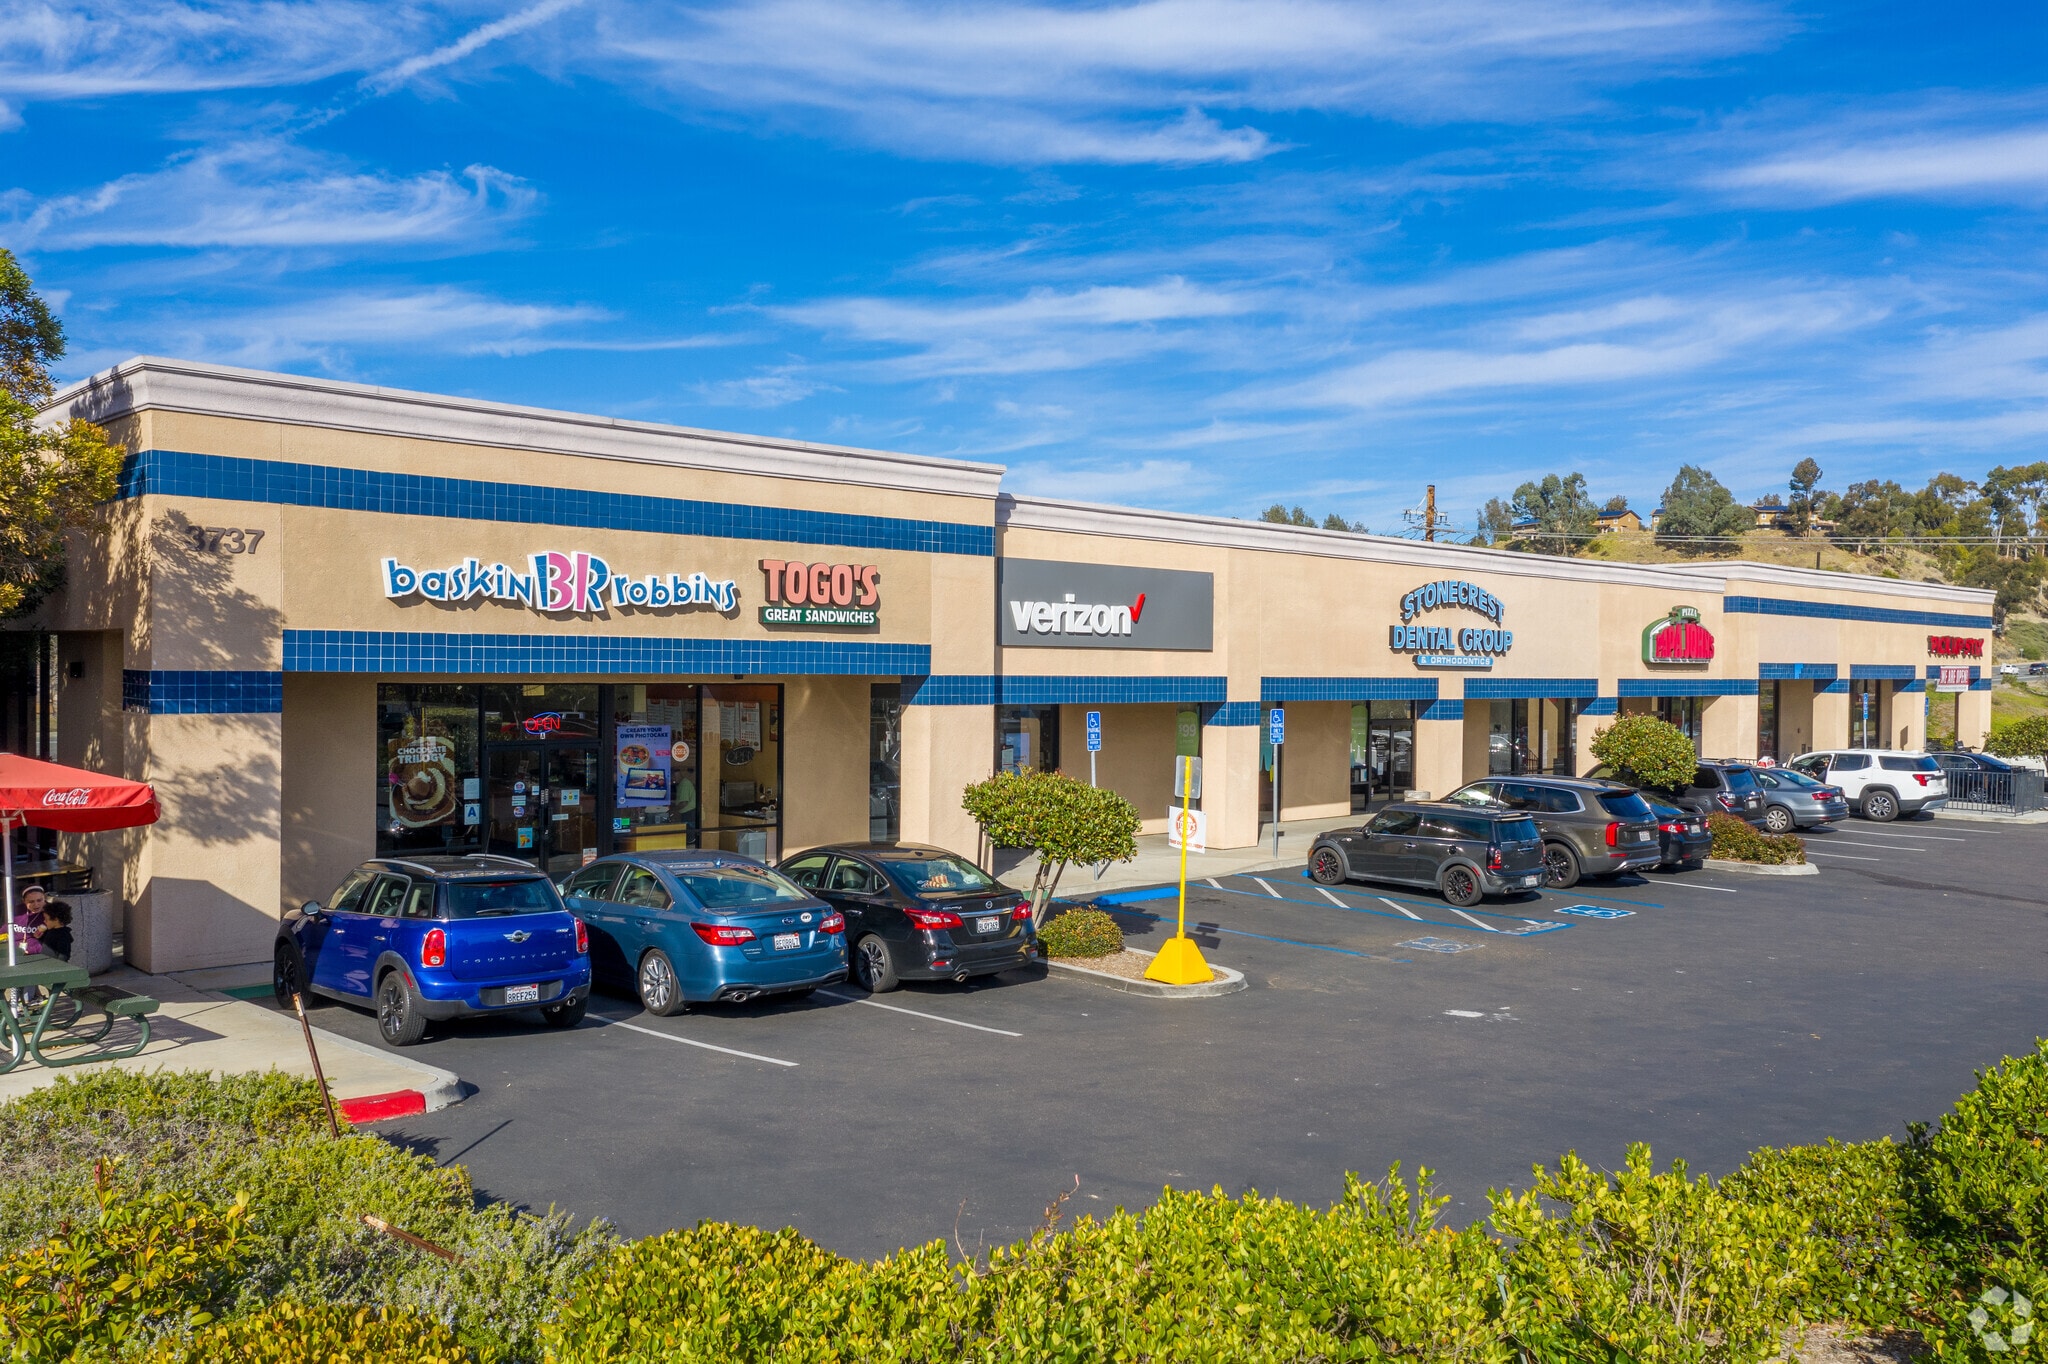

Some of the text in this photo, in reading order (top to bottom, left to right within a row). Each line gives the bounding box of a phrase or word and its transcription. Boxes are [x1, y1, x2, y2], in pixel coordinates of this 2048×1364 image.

[185, 526, 265, 554] 3737
[381, 557, 533, 607] baskin
[611, 571, 738, 612] robbins
[762, 559, 878, 606] TOGO'S
[1403, 579, 1506, 623] STONECREST
[765, 608, 875, 624] GREAT SANDWICHES
[1010, 593, 1132, 635] verizon
[1681, 608, 1698, 617] PIZZA
[1393, 625, 1514, 652] DENTAL GROUP
[1655, 623, 1682, 659] PAPA
[1421, 656, 1491, 665] & ORTHODONTICS
[525, 717, 561, 731] OPEN
[397, 746, 447, 755] CHOCOLATE
[397, 753, 446, 764] TRILOGY
[467, 807, 477, 818] A
[13, 924, 37, 933] Reebo
